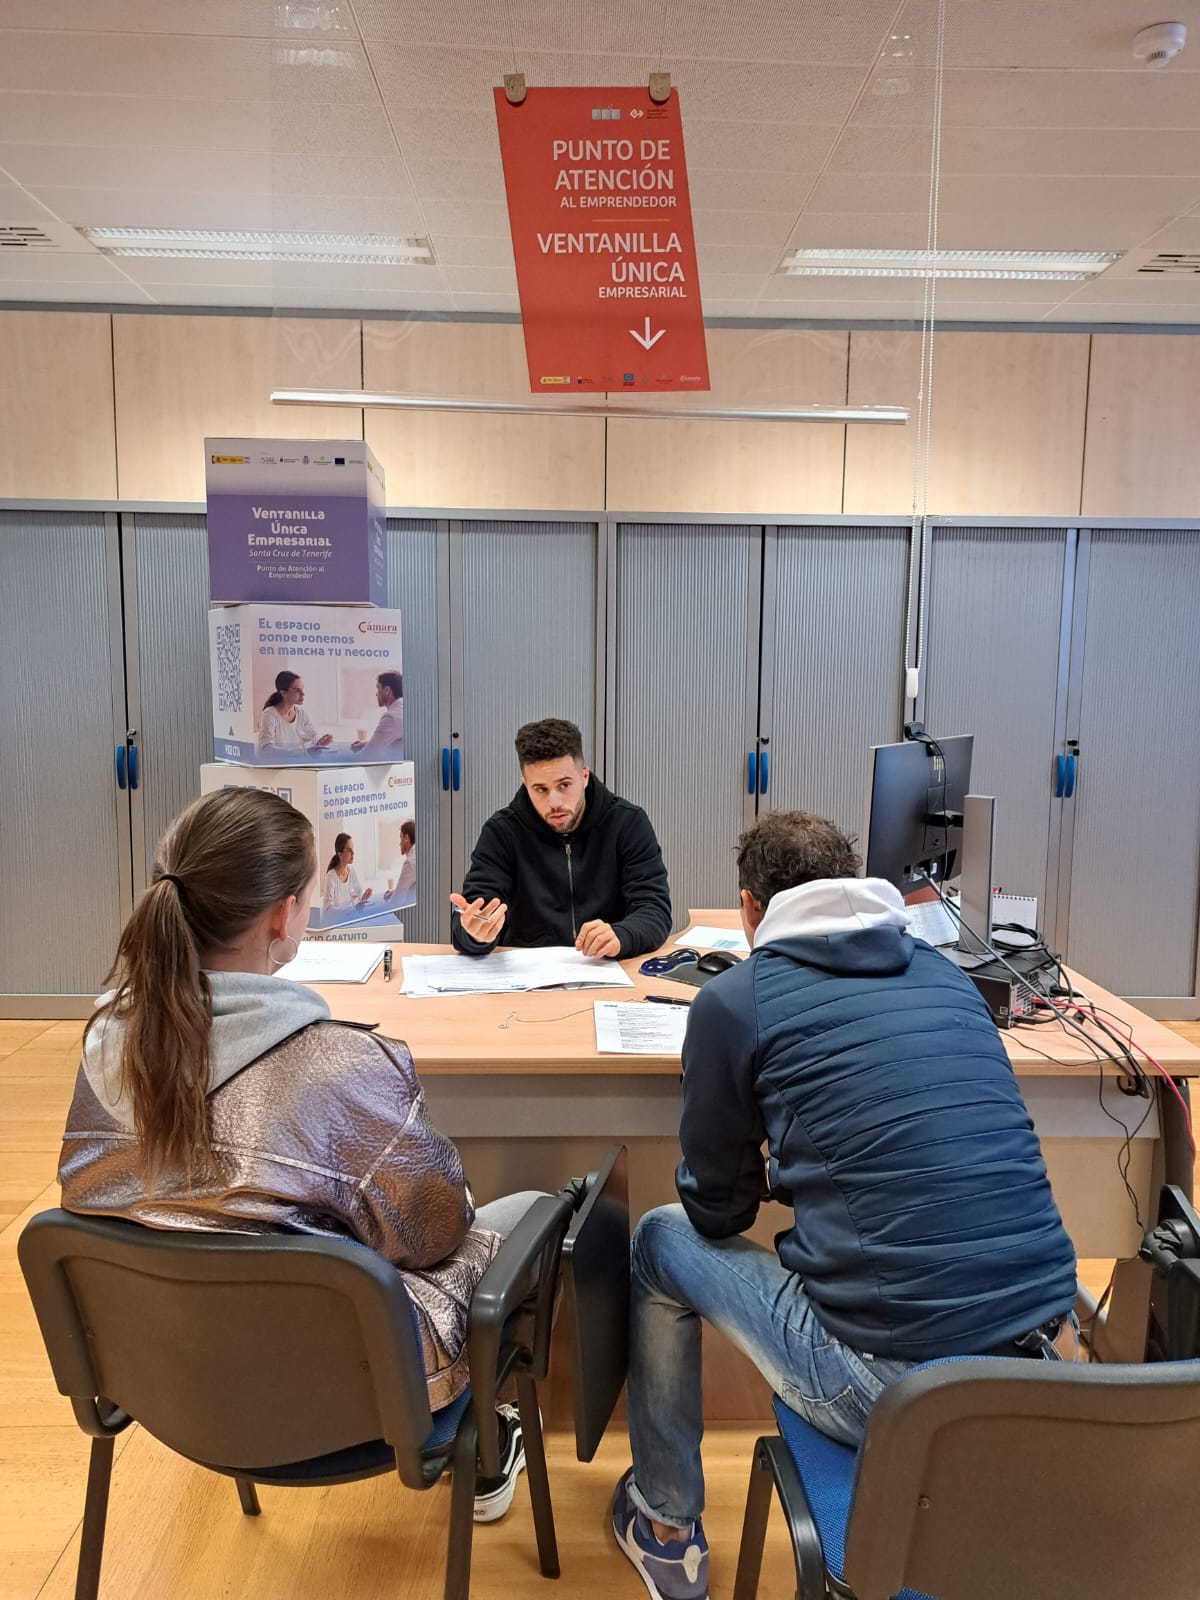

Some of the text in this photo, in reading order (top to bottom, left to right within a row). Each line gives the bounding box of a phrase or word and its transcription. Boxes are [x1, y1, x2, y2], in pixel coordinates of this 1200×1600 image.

[553, 139, 671, 161] PUNTO DE
[554, 162, 674, 191] ATENCIÓN
[560, 195, 677, 208] AL EMPRENDEDOR
[536, 232, 683, 254] VENTANILLA
[611, 256, 686, 283] ÚNICA
[599, 286, 687, 299] EMPRESARIAL
[249, 549, 333, 560] Santa Cruz de Tenerife
[256, 564, 277, 572] Punto
[278, 564, 287, 572] de
[288, 564, 317, 572] Atención
[269, 571, 313, 579] Emprendedor
[358, 621, 397, 633] Cámara
[326, 932, 368, 942] GRATUITO
